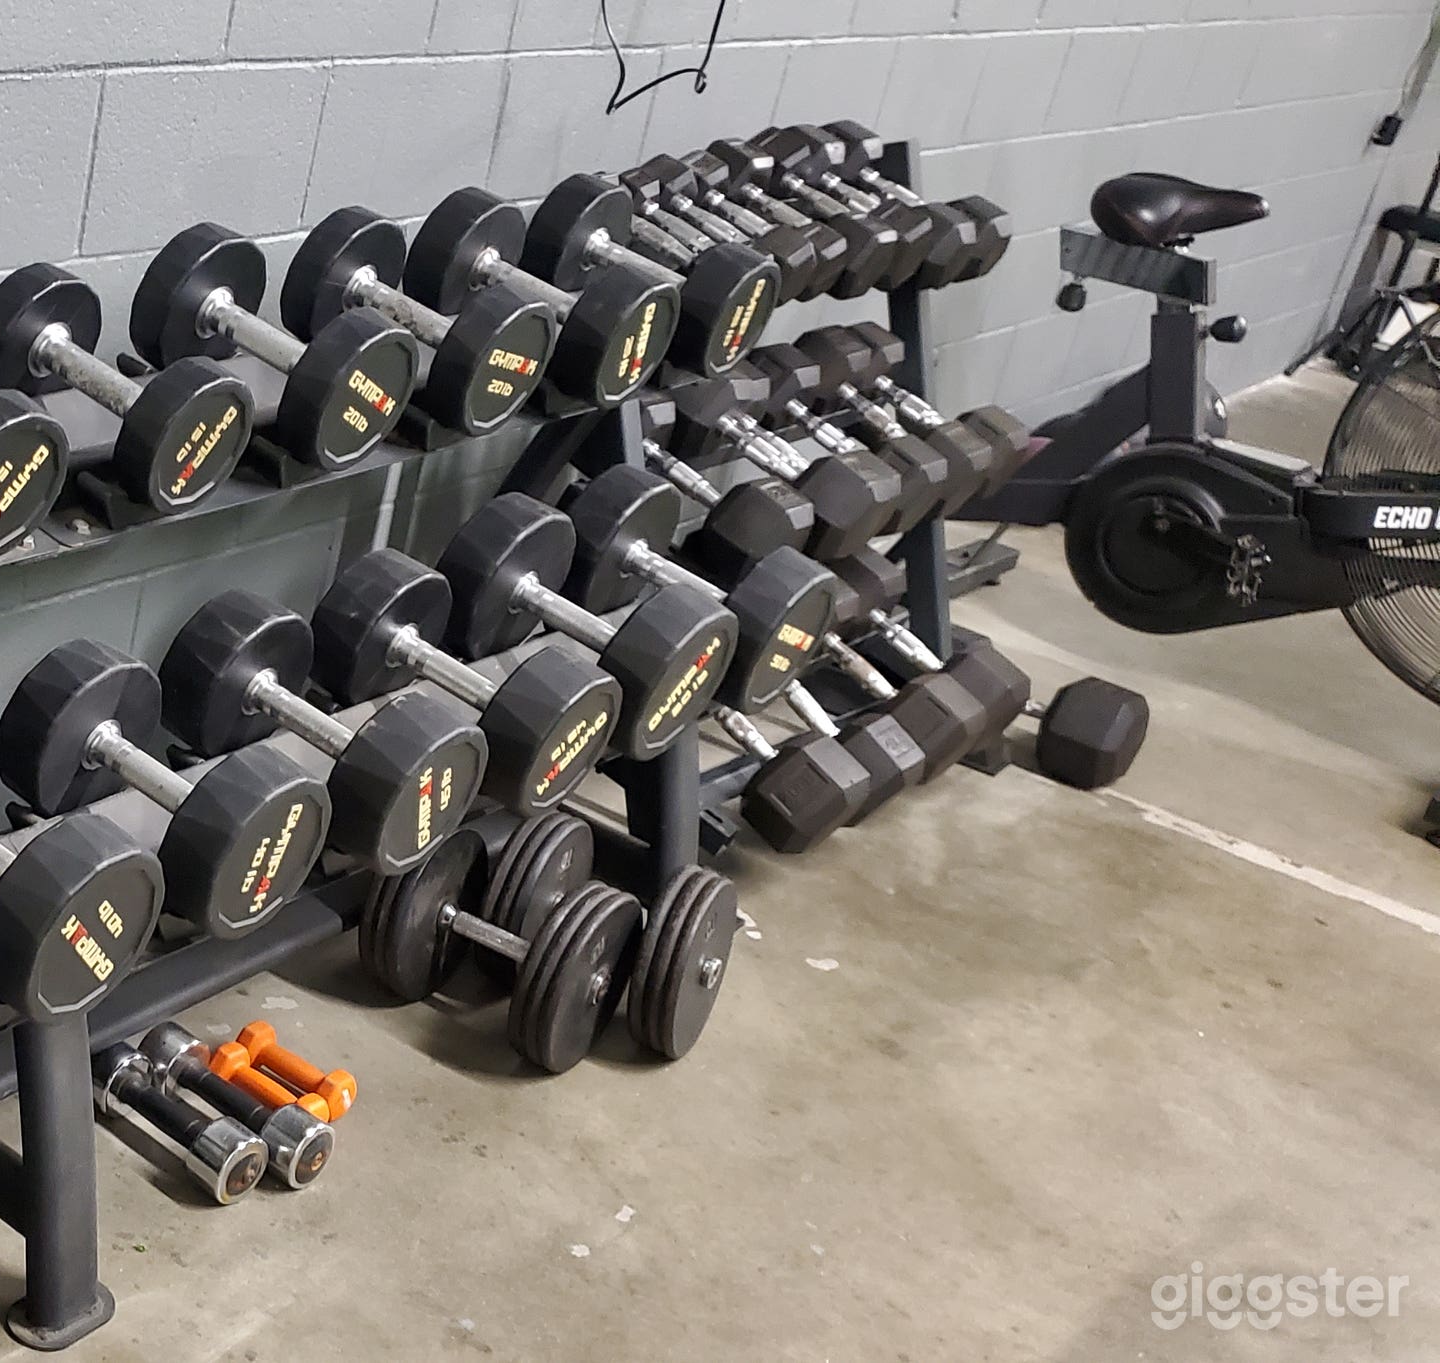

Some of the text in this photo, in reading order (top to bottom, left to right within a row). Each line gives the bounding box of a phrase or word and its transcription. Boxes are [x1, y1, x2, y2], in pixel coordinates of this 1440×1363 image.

[488, 348, 539, 376] GYMPAK
[628, 302, 657, 385] GYMPAK
[348, 369, 396, 417] GYMPAK
[170, 405, 238, 495] GYMPAK
[176, 421, 207, 463] 15 lb
[1373, 505, 1434, 530] ECHO
[648, 637, 721, 731] GYMPAK
[536, 711, 608, 796] GYMPAK
[417, 767, 433, 850] GYMPAK
[241, 837, 271, 893] 40 lb
[249, 803, 303, 913] GYMPAK
[60, 914, 115, 982] GYMPAK
